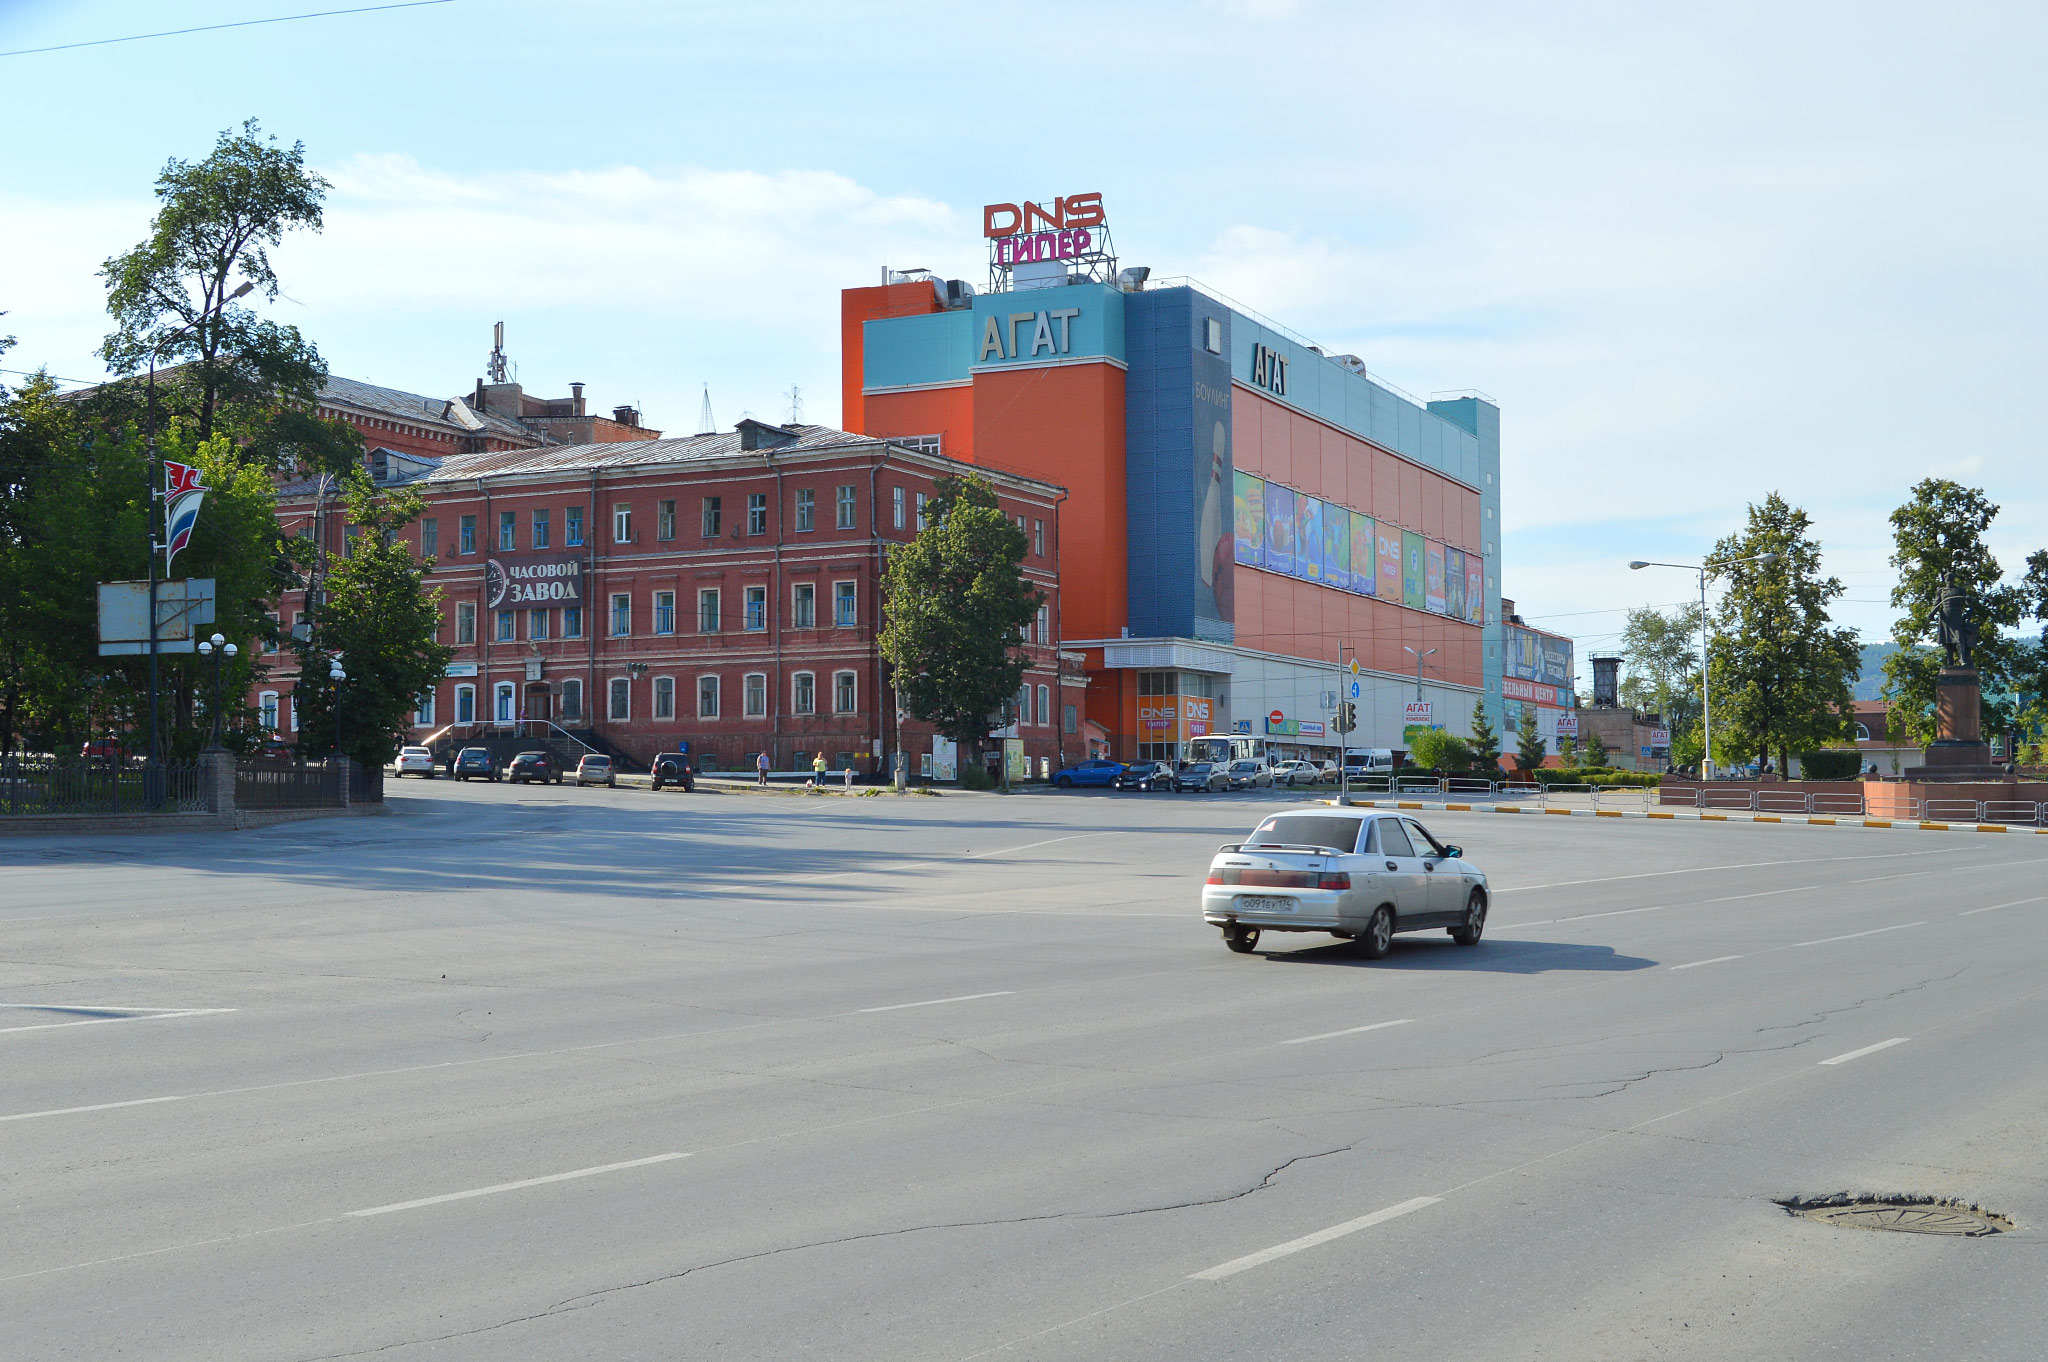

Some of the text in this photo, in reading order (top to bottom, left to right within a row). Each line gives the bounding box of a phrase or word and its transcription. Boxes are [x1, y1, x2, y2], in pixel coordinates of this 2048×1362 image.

[984, 192, 1104, 238] DNS
[997, 230, 1091, 265] ГИПЕР
[980, 308, 1079, 361] АГАТ
[1252, 342, 1289, 395] АГАТ
[1378, 536, 1400, 560] DNS
[510, 561, 578, 578] ЧАСОВОЙ
[510, 581, 579, 602] ЗАВОД
[1534, 686, 1554, 703] ЦЕНТР
[1140, 707, 1176, 718] DNS
[1186, 701, 1209, 719] DNS
[1406, 703, 1430, 713] АГАТ
[1557, 718, 1577, 727] АГАТ
[1652, 731, 1669, 739] АГАТ
